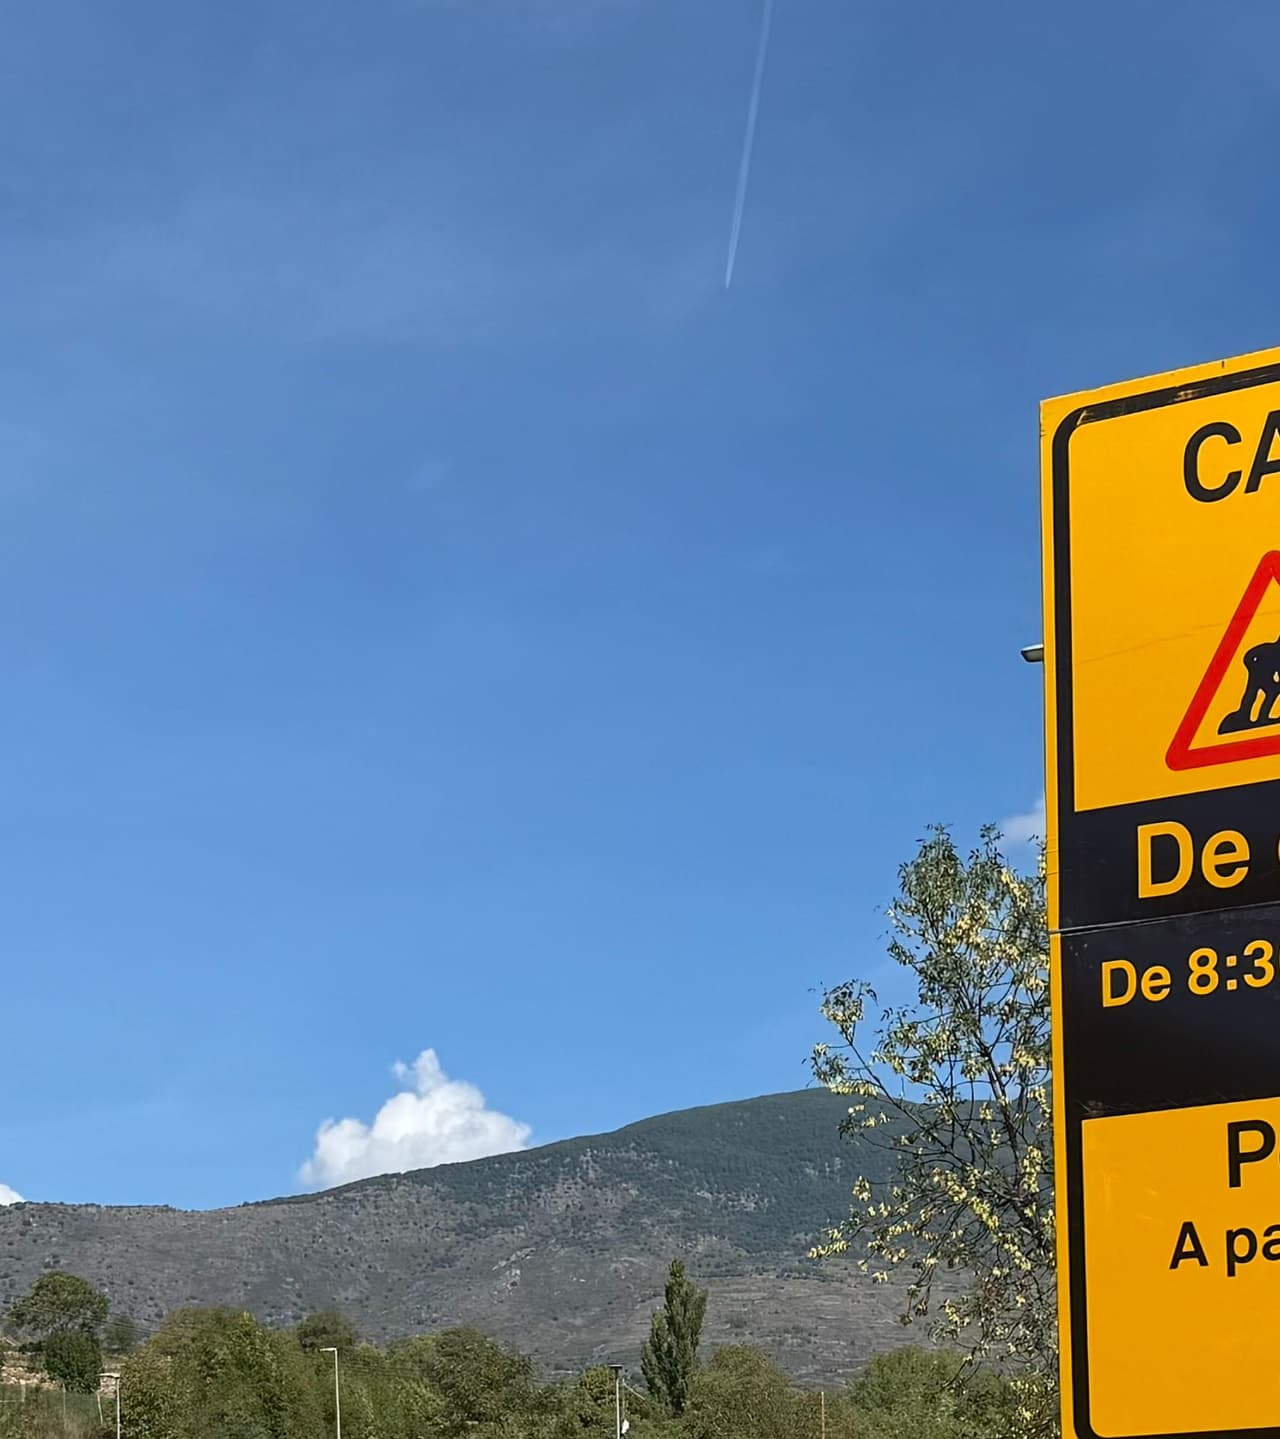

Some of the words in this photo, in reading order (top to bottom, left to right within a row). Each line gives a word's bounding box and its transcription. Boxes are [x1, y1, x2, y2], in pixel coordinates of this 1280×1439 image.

[1138, 822, 1249, 898] De
[1102, 960, 1171, 1007] De
[1170, 1222, 1208, 1269] A
